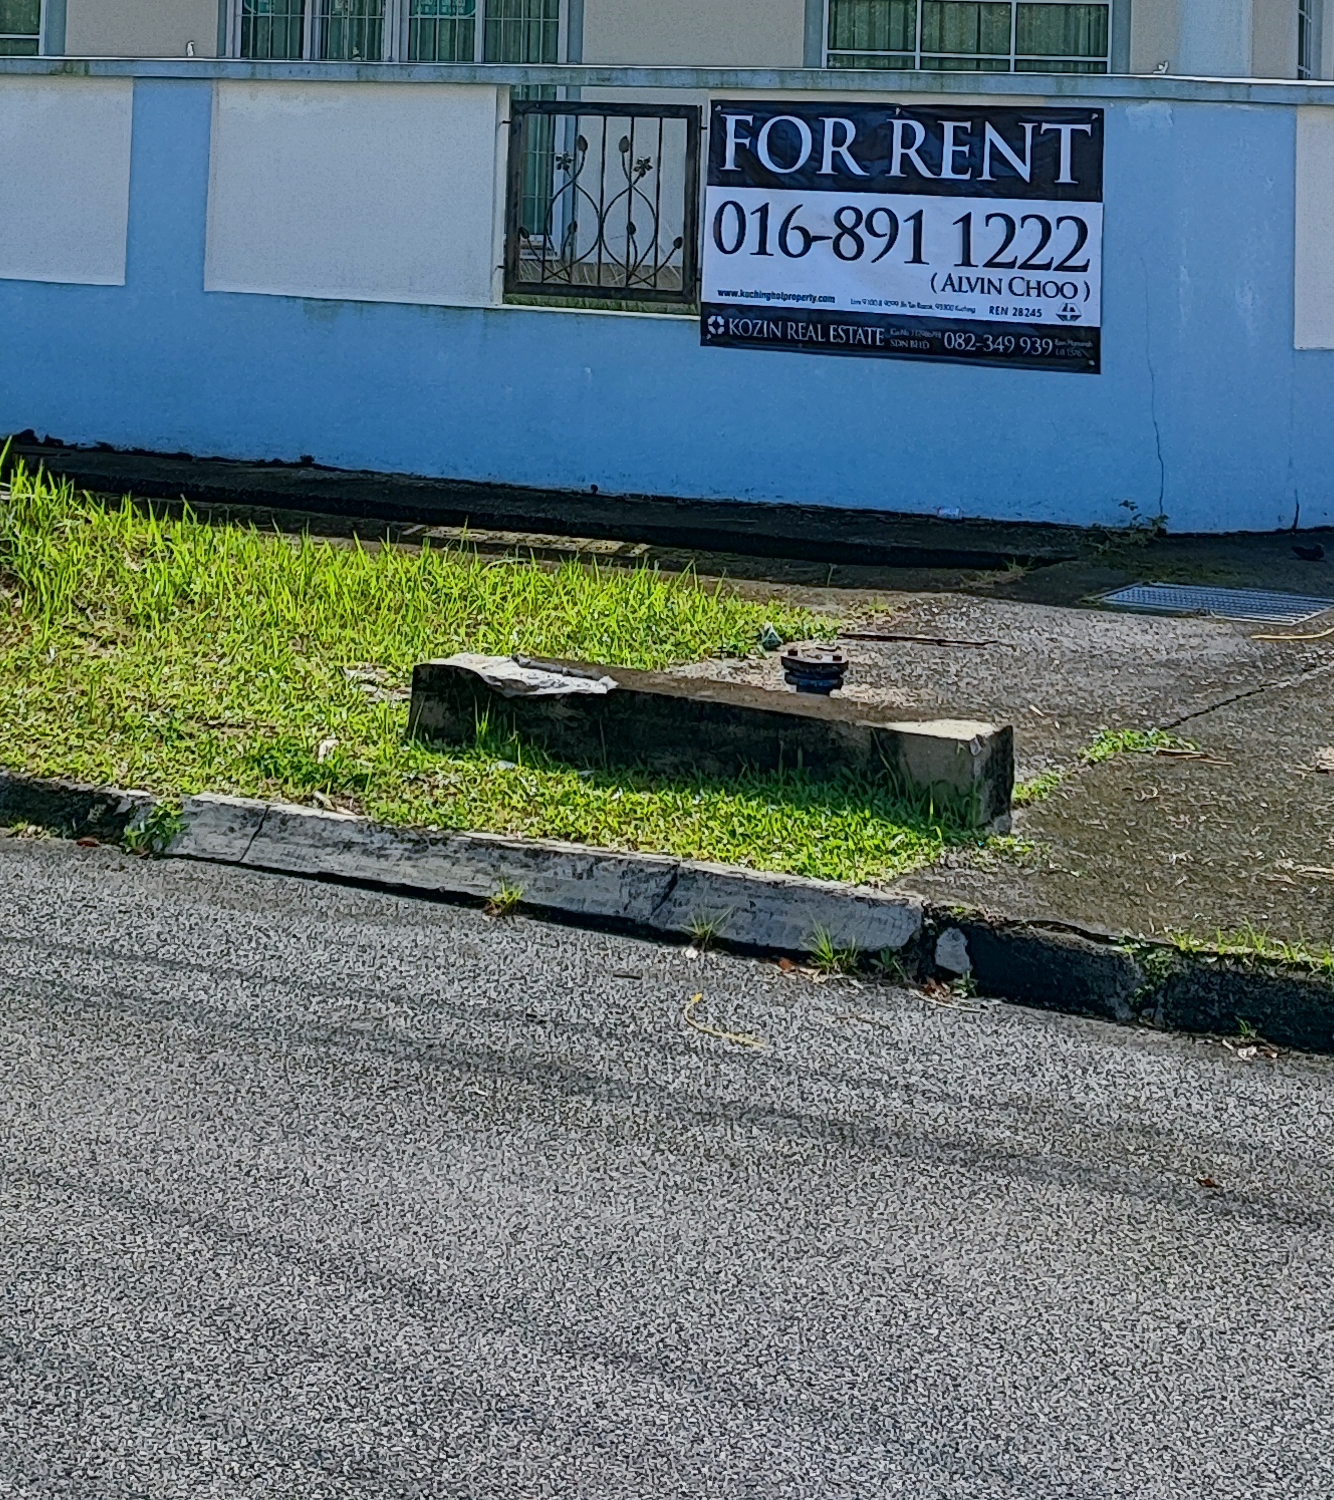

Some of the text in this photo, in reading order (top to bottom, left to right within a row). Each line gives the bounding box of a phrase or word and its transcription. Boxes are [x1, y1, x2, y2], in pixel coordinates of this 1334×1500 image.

[719, 113, 1092, 185] FOR RENT
[712, 200, 1091, 273] 016-891 1222
[988, 305, 1043, 318] REN 28245
[728, 317, 782, 339] KOZIN
[786, 321, 826, 342] REAL
[829, 324, 885, 347] ESTATE
[943, 331, 1015, 353] 082-349
[1019, 336, 1053, 356] 939
